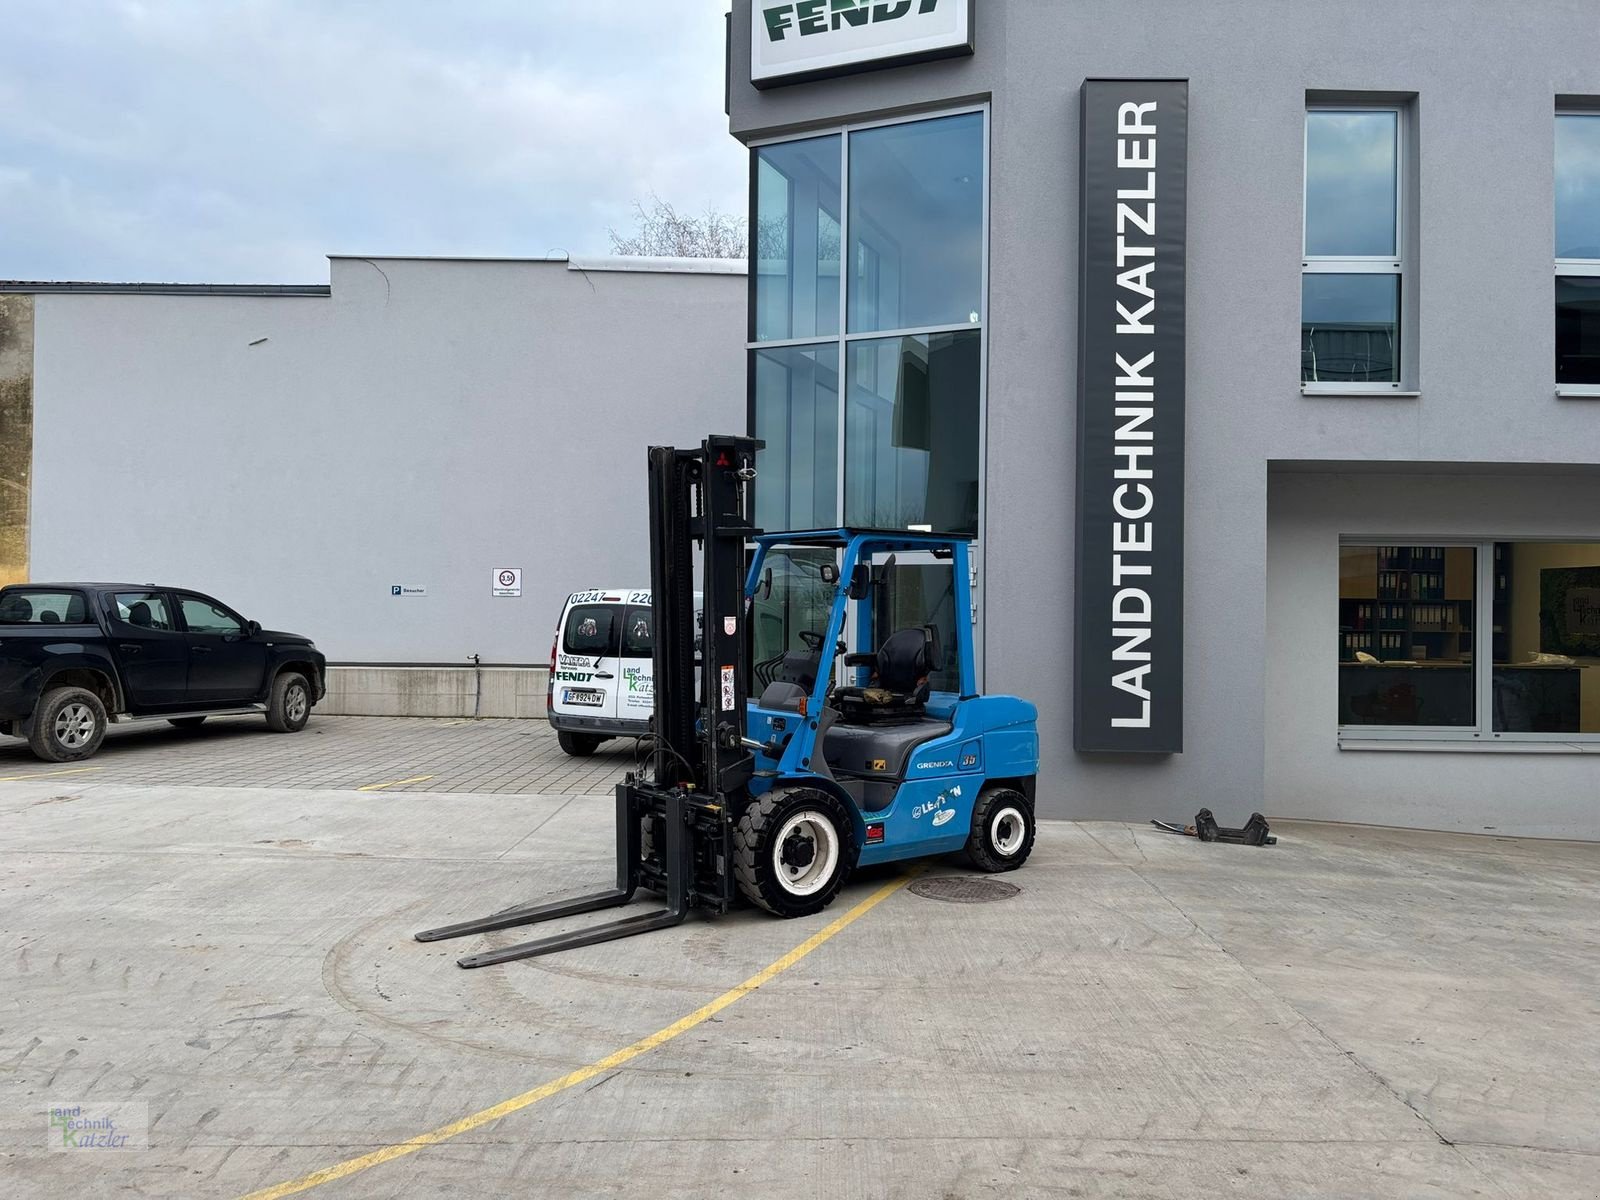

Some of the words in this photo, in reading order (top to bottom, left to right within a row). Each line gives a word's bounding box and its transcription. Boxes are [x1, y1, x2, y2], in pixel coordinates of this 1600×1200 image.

[1115, 100, 1158, 334] KATZLER
[1110, 351, 1156, 729] LANDTECHNIK
[570, 592, 606, 604] 02247
[558, 654, 591, 667] VALTRA
[556, 671, 595, 683] FENDT
[623, 667, 641, 679] Land
